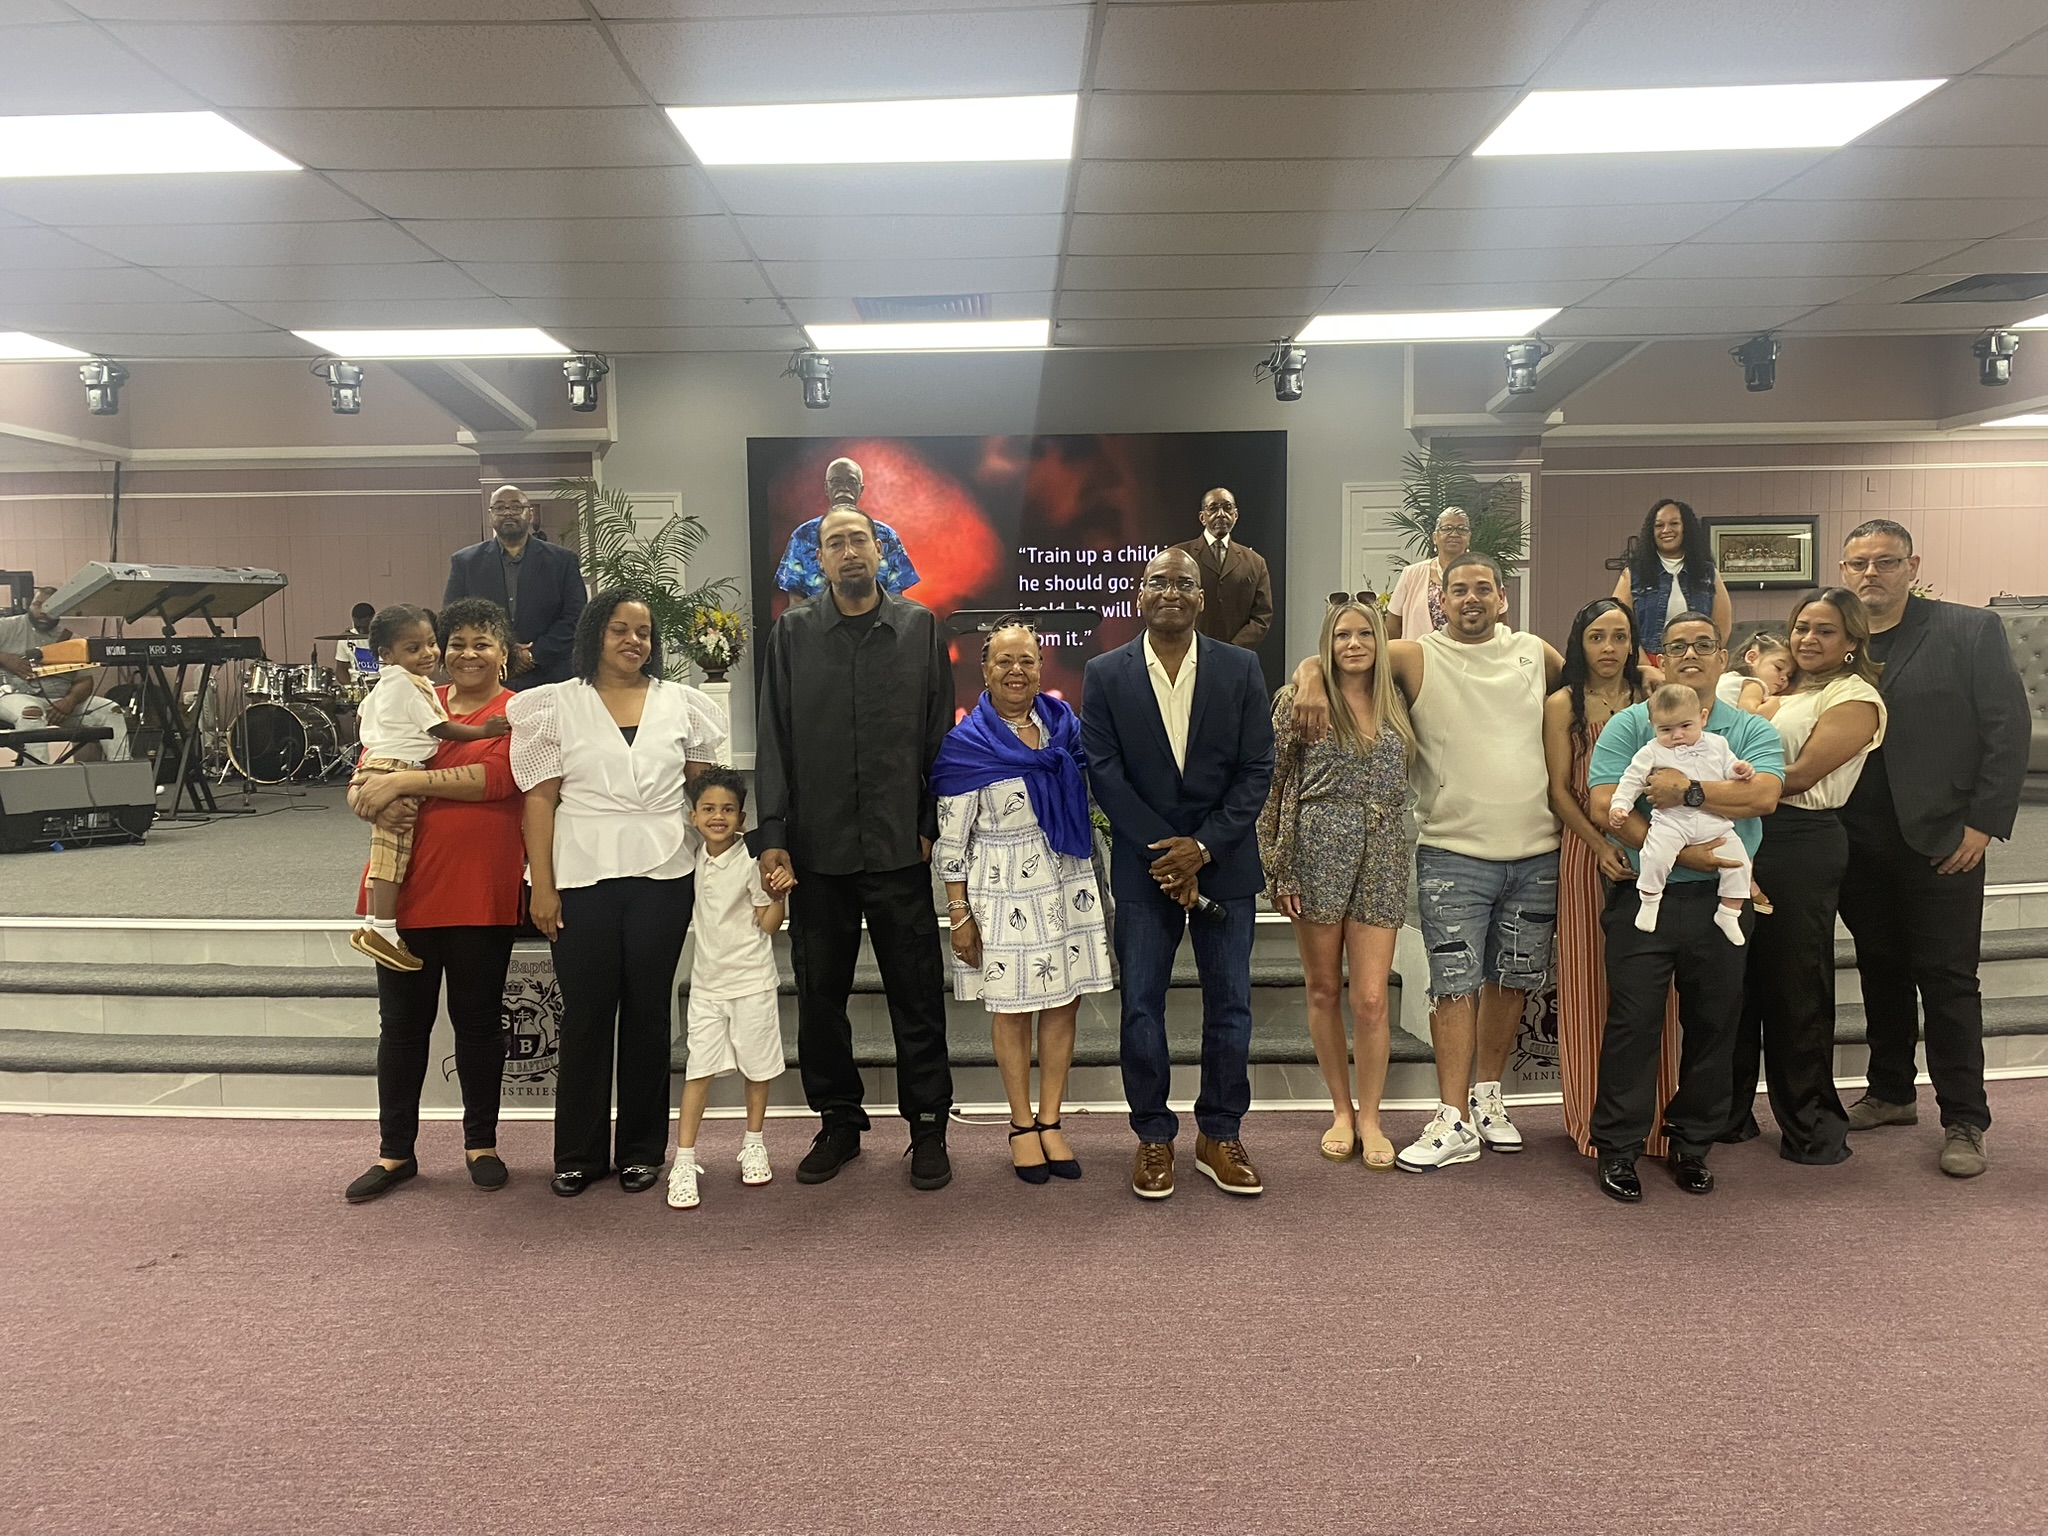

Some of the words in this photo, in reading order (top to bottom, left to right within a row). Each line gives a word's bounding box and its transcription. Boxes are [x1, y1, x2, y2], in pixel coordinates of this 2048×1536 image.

[1018, 547, 1071, 564] “Train
[1076, 550, 1097, 566] up
[1102, 550, 1112, 563] a
[1117, 545, 1158, 562] child
[1019, 575, 1040, 591] he
[1045, 574, 1103, 591] should
[1108, 577, 1135, 593] go:
[1101, 601, 1132, 618] will
[148, 645, 183, 655] KROOS
[358, 661, 378, 670] OLO
[508, 959, 555, 977] Bapti
[519, 1039, 533, 1054] B
[1528, 1042, 1559, 1056] SHILO
[502, 1087, 557, 1096] ISTRIES
